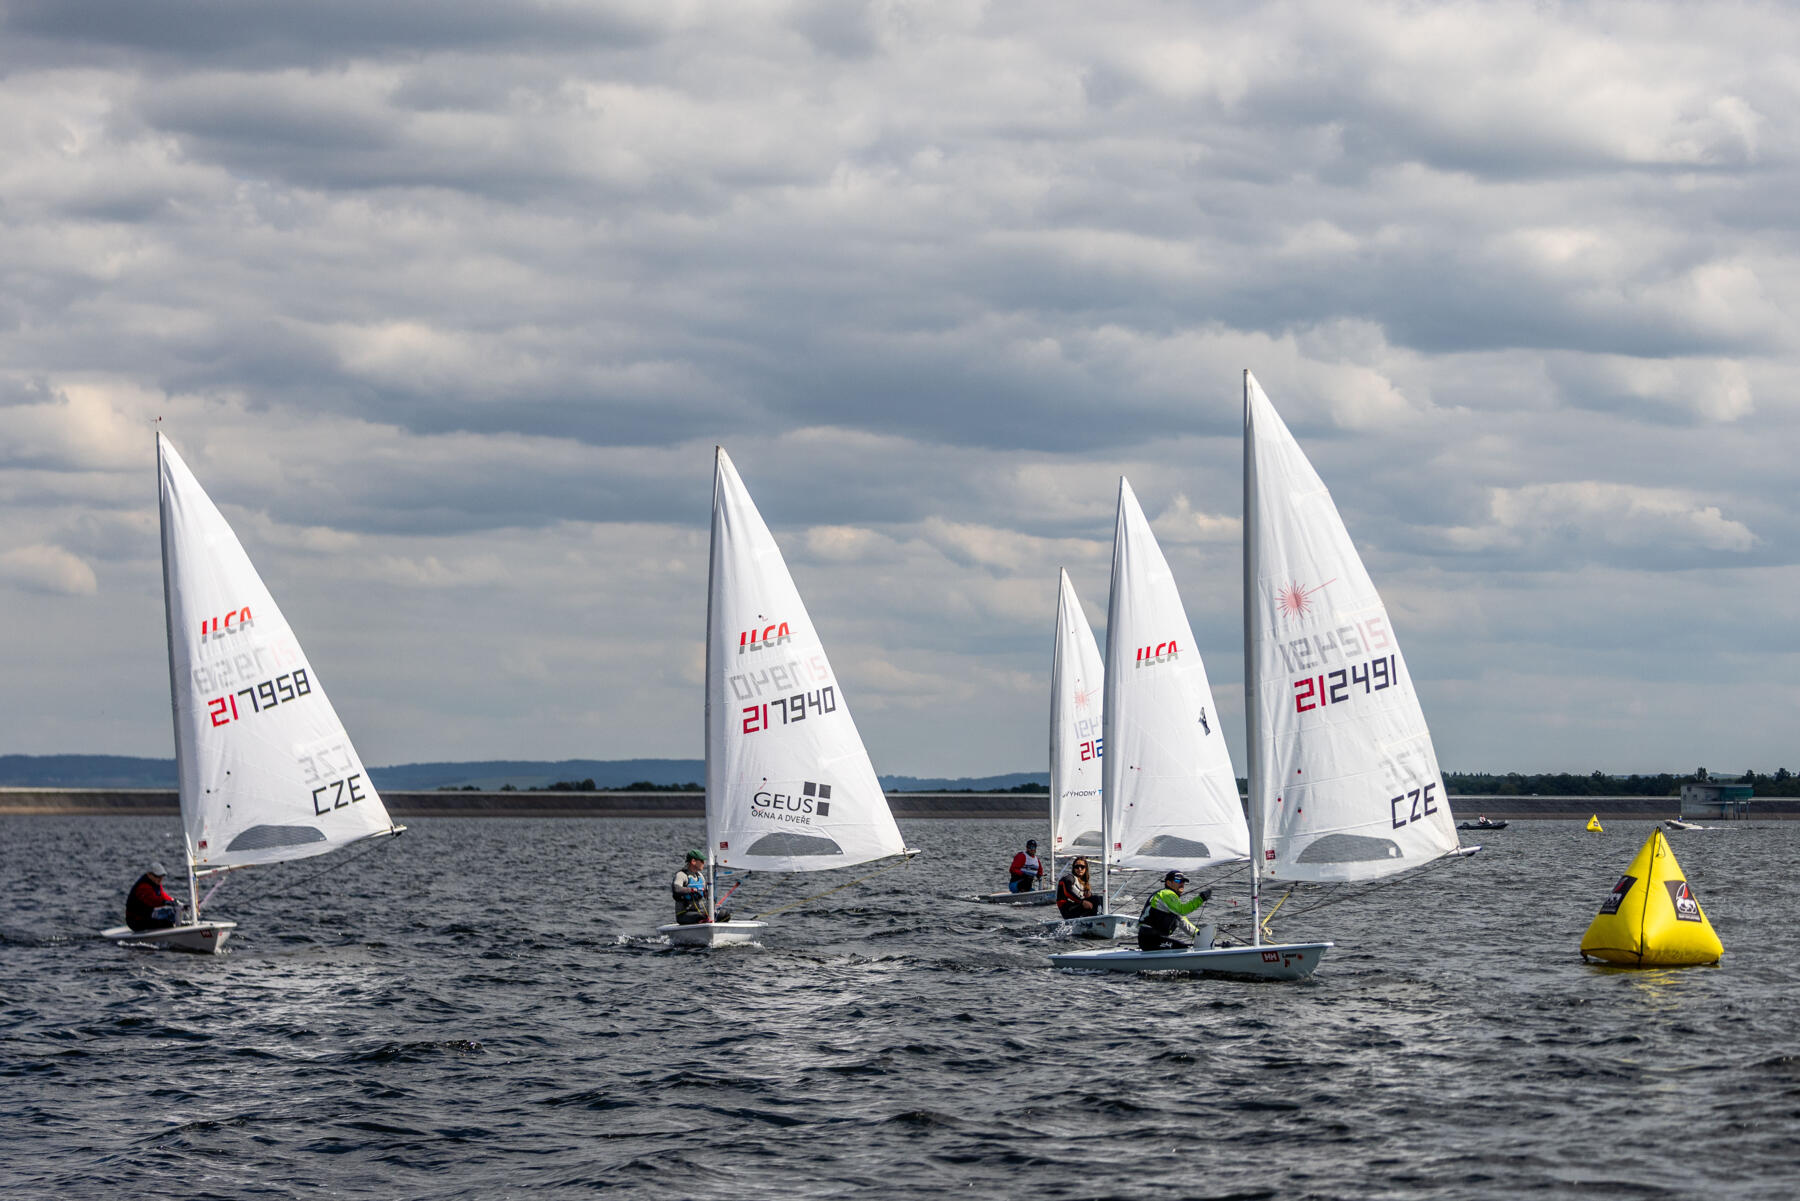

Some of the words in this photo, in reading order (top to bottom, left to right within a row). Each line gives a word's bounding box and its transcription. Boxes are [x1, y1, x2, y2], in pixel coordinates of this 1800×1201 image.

[202, 606, 254, 644] ILCA
[739, 622, 792, 654] ILCA
[1135, 640, 1179, 669] ILCA
[208, 668, 312, 728] 217958
[1294, 654, 1398, 713] 212491
[742, 686, 836, 734] 217940
[312, 774, 366, 816] CZE
[753, 791, 814, 814] GEUS
[1390, 782, 1438, 830] CZE
[751, 809, 776, 820] OKNA
[785, 814, 811, 825] DVEŘE
